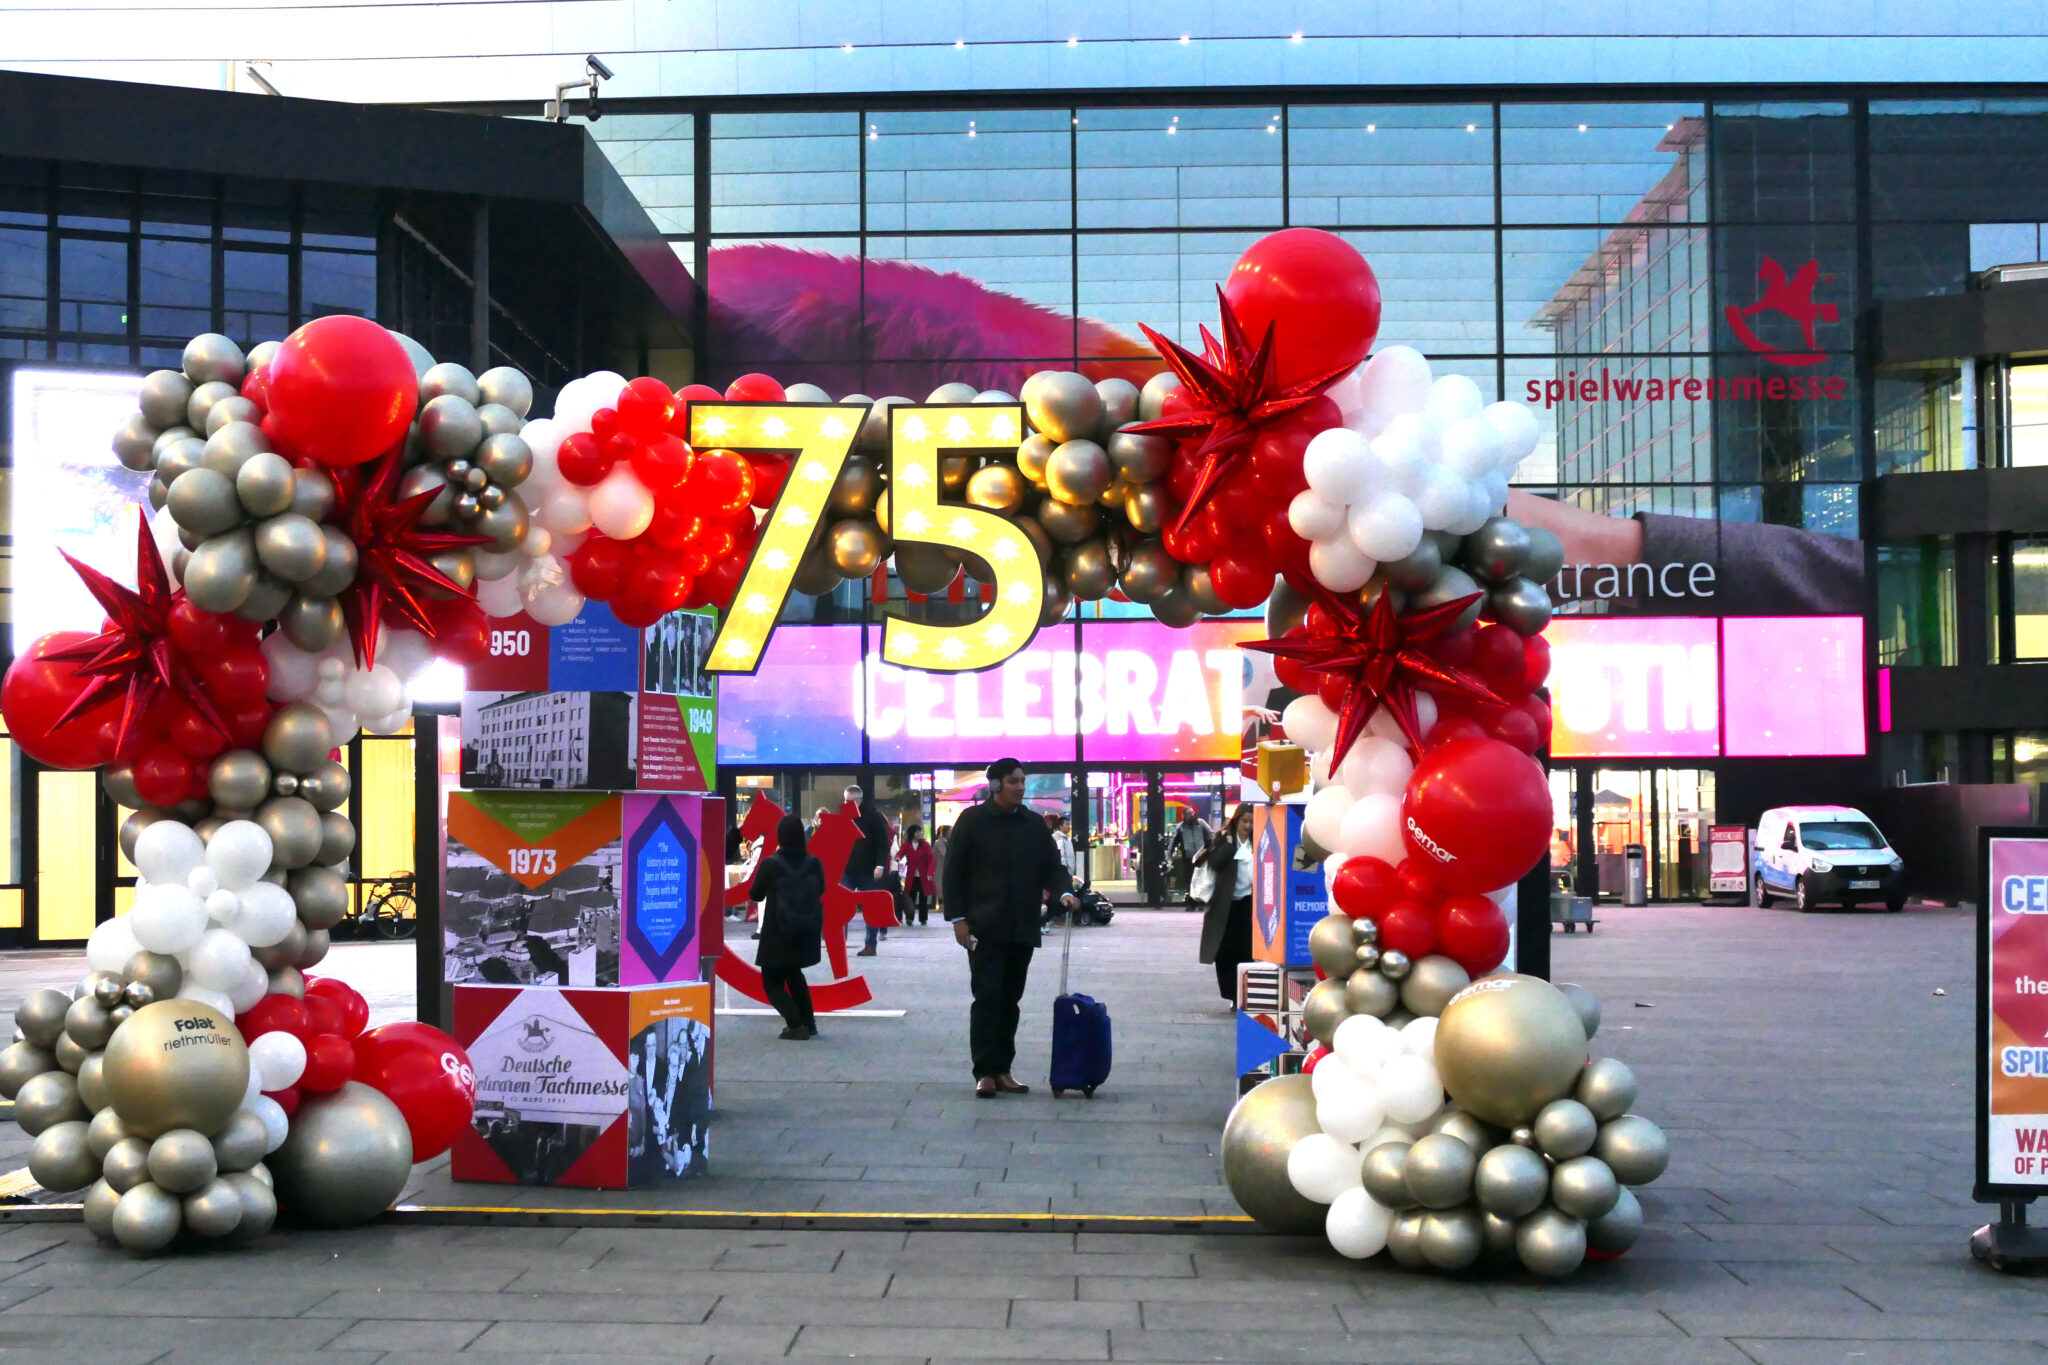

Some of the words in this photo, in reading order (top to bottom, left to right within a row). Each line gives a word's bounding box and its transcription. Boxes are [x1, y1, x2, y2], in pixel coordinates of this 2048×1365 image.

[1526, 368, 1845, 410] spielwarenmesse
[686, 401, 1044, 674] 75
[1546, 562, 1716, 598] trance
[688, 707, 713, 735] 1949
[1407, 816, 1458, 863] Gemar
[508, 848, 557, 875] 1973
[2003, 877, 2048, 913] CE
[173, 1016, 216, 1032] Folat
[163, 1033, 233, 1051] riethmüller
[501, 1054, 572, 1074] Deutsche
[2014, 1157, 2036, 1175] OF
